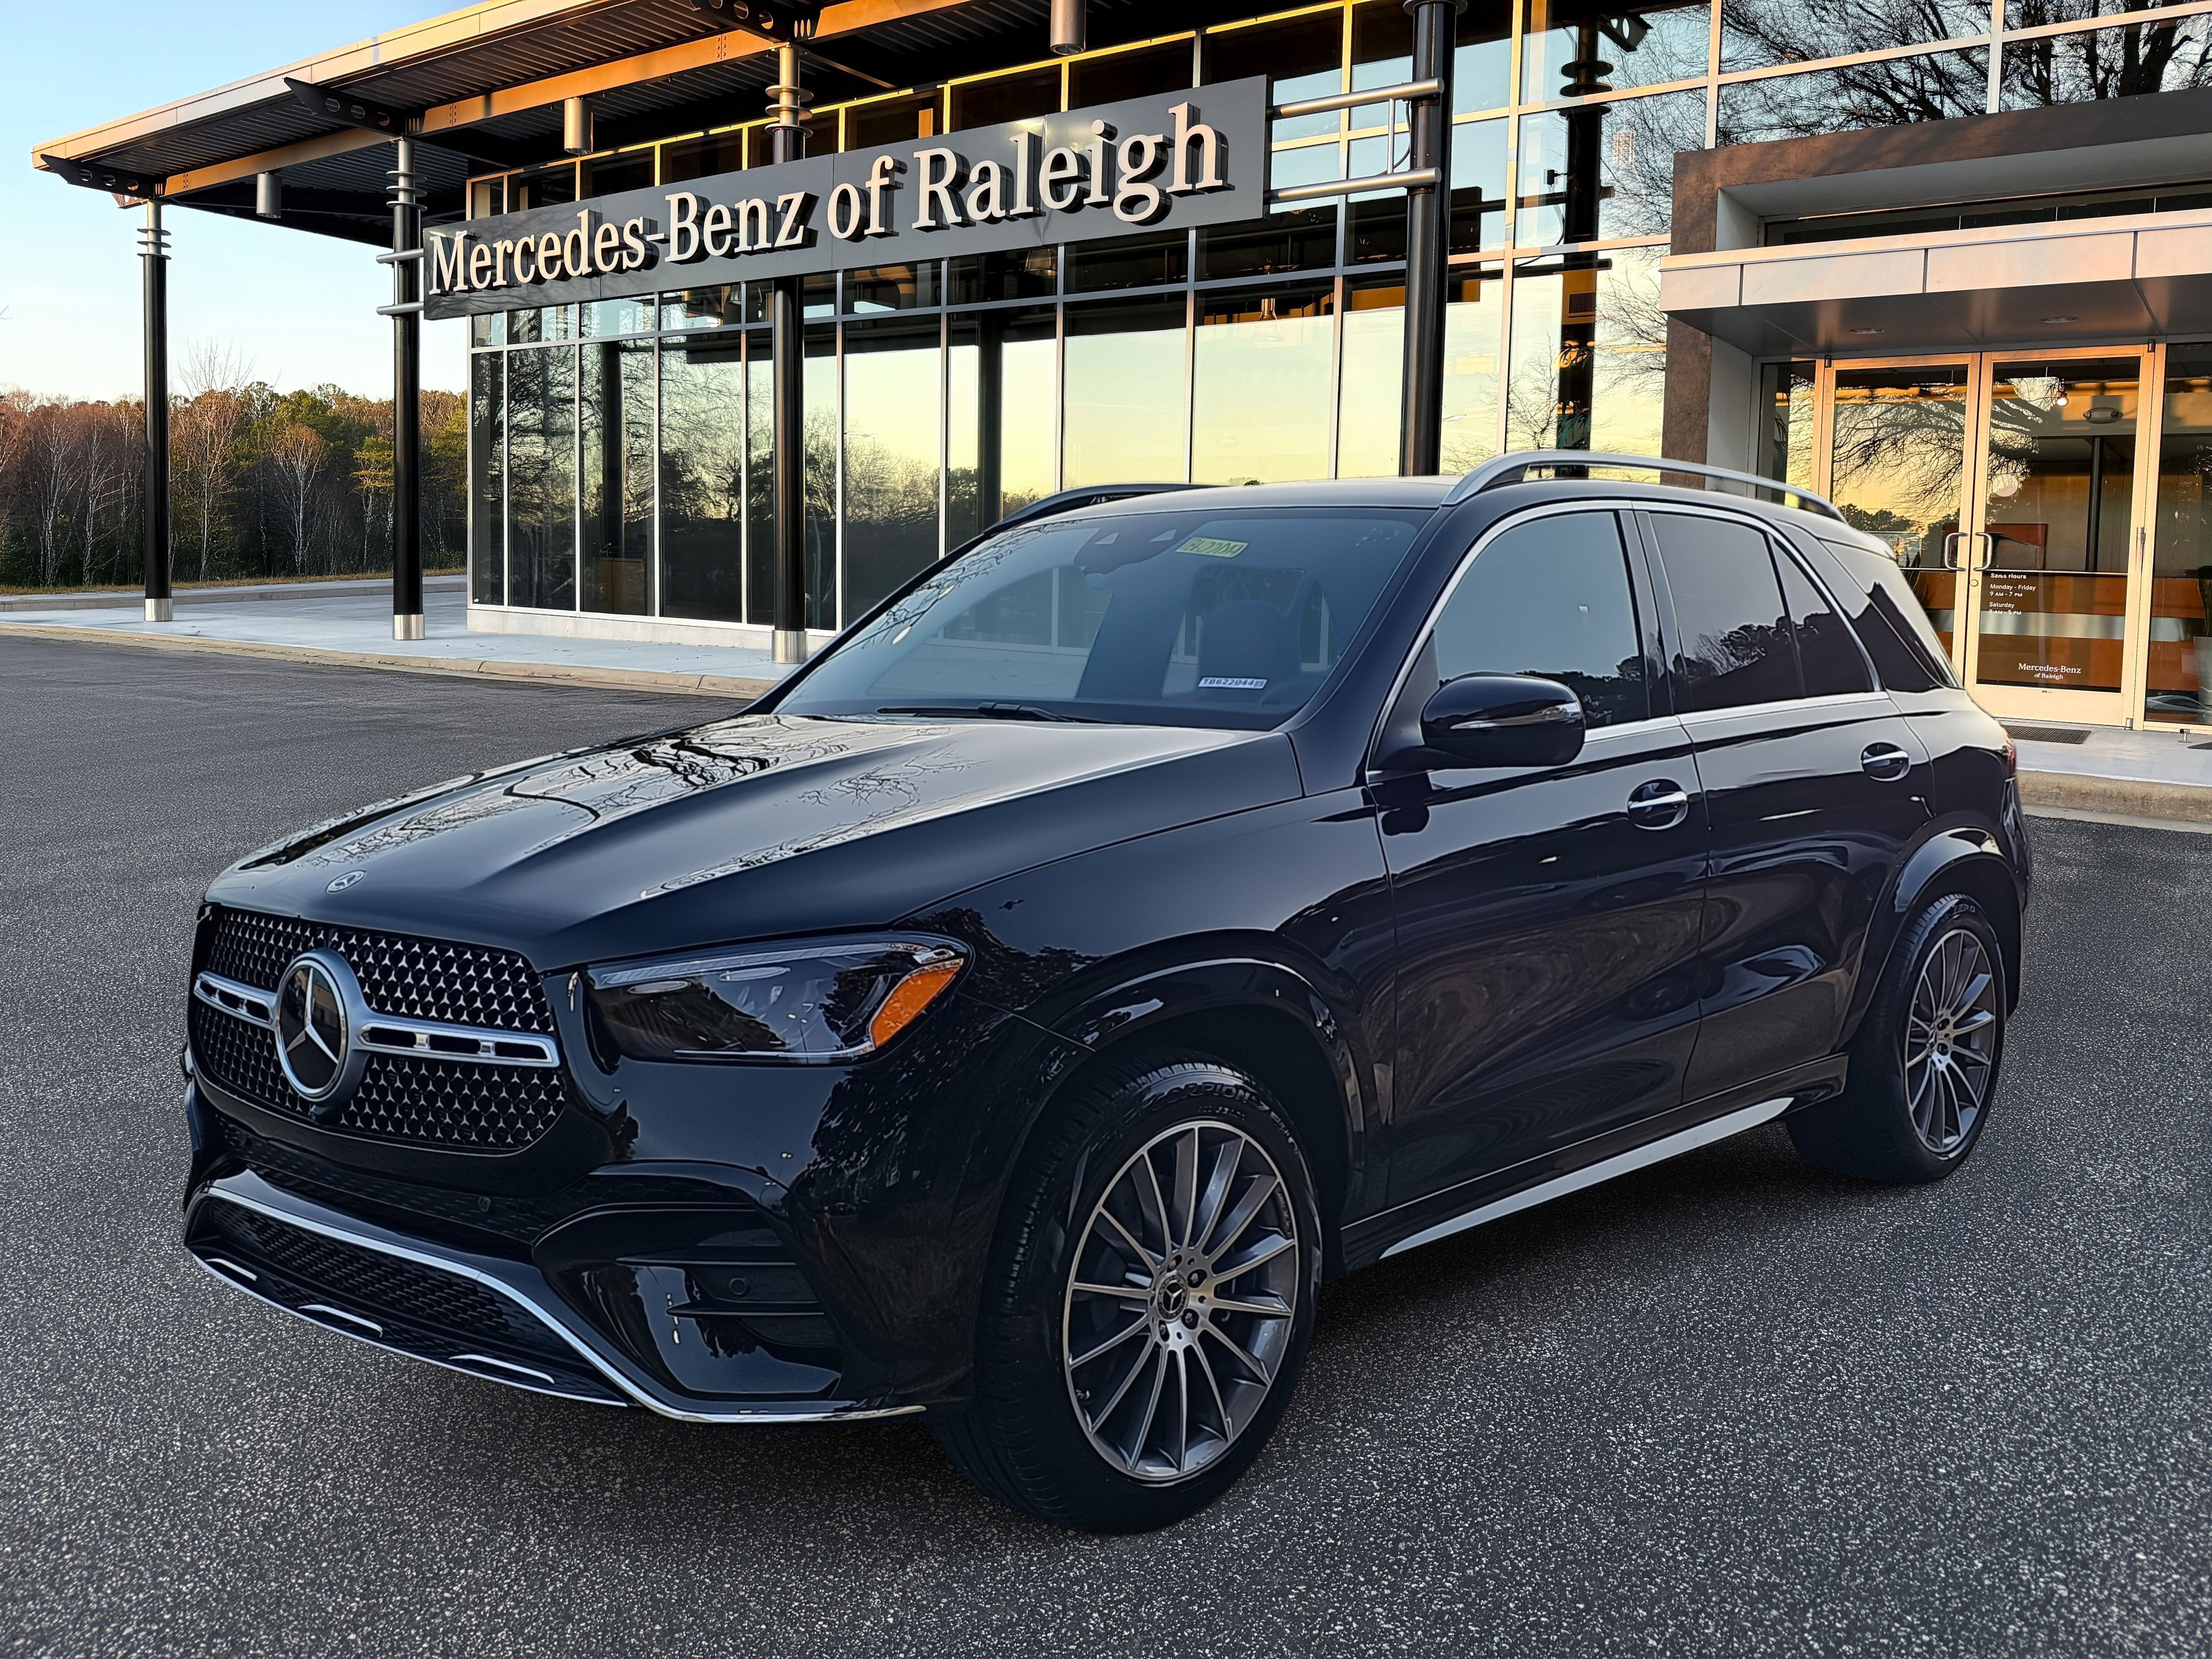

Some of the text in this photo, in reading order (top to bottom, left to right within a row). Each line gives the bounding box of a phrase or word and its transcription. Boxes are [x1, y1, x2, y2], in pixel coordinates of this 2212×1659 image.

[429, 101, 1223, 294] Mercedes-Benz of Raleigh
[2018, 663, 2081, 673] Mercedes-Benz
